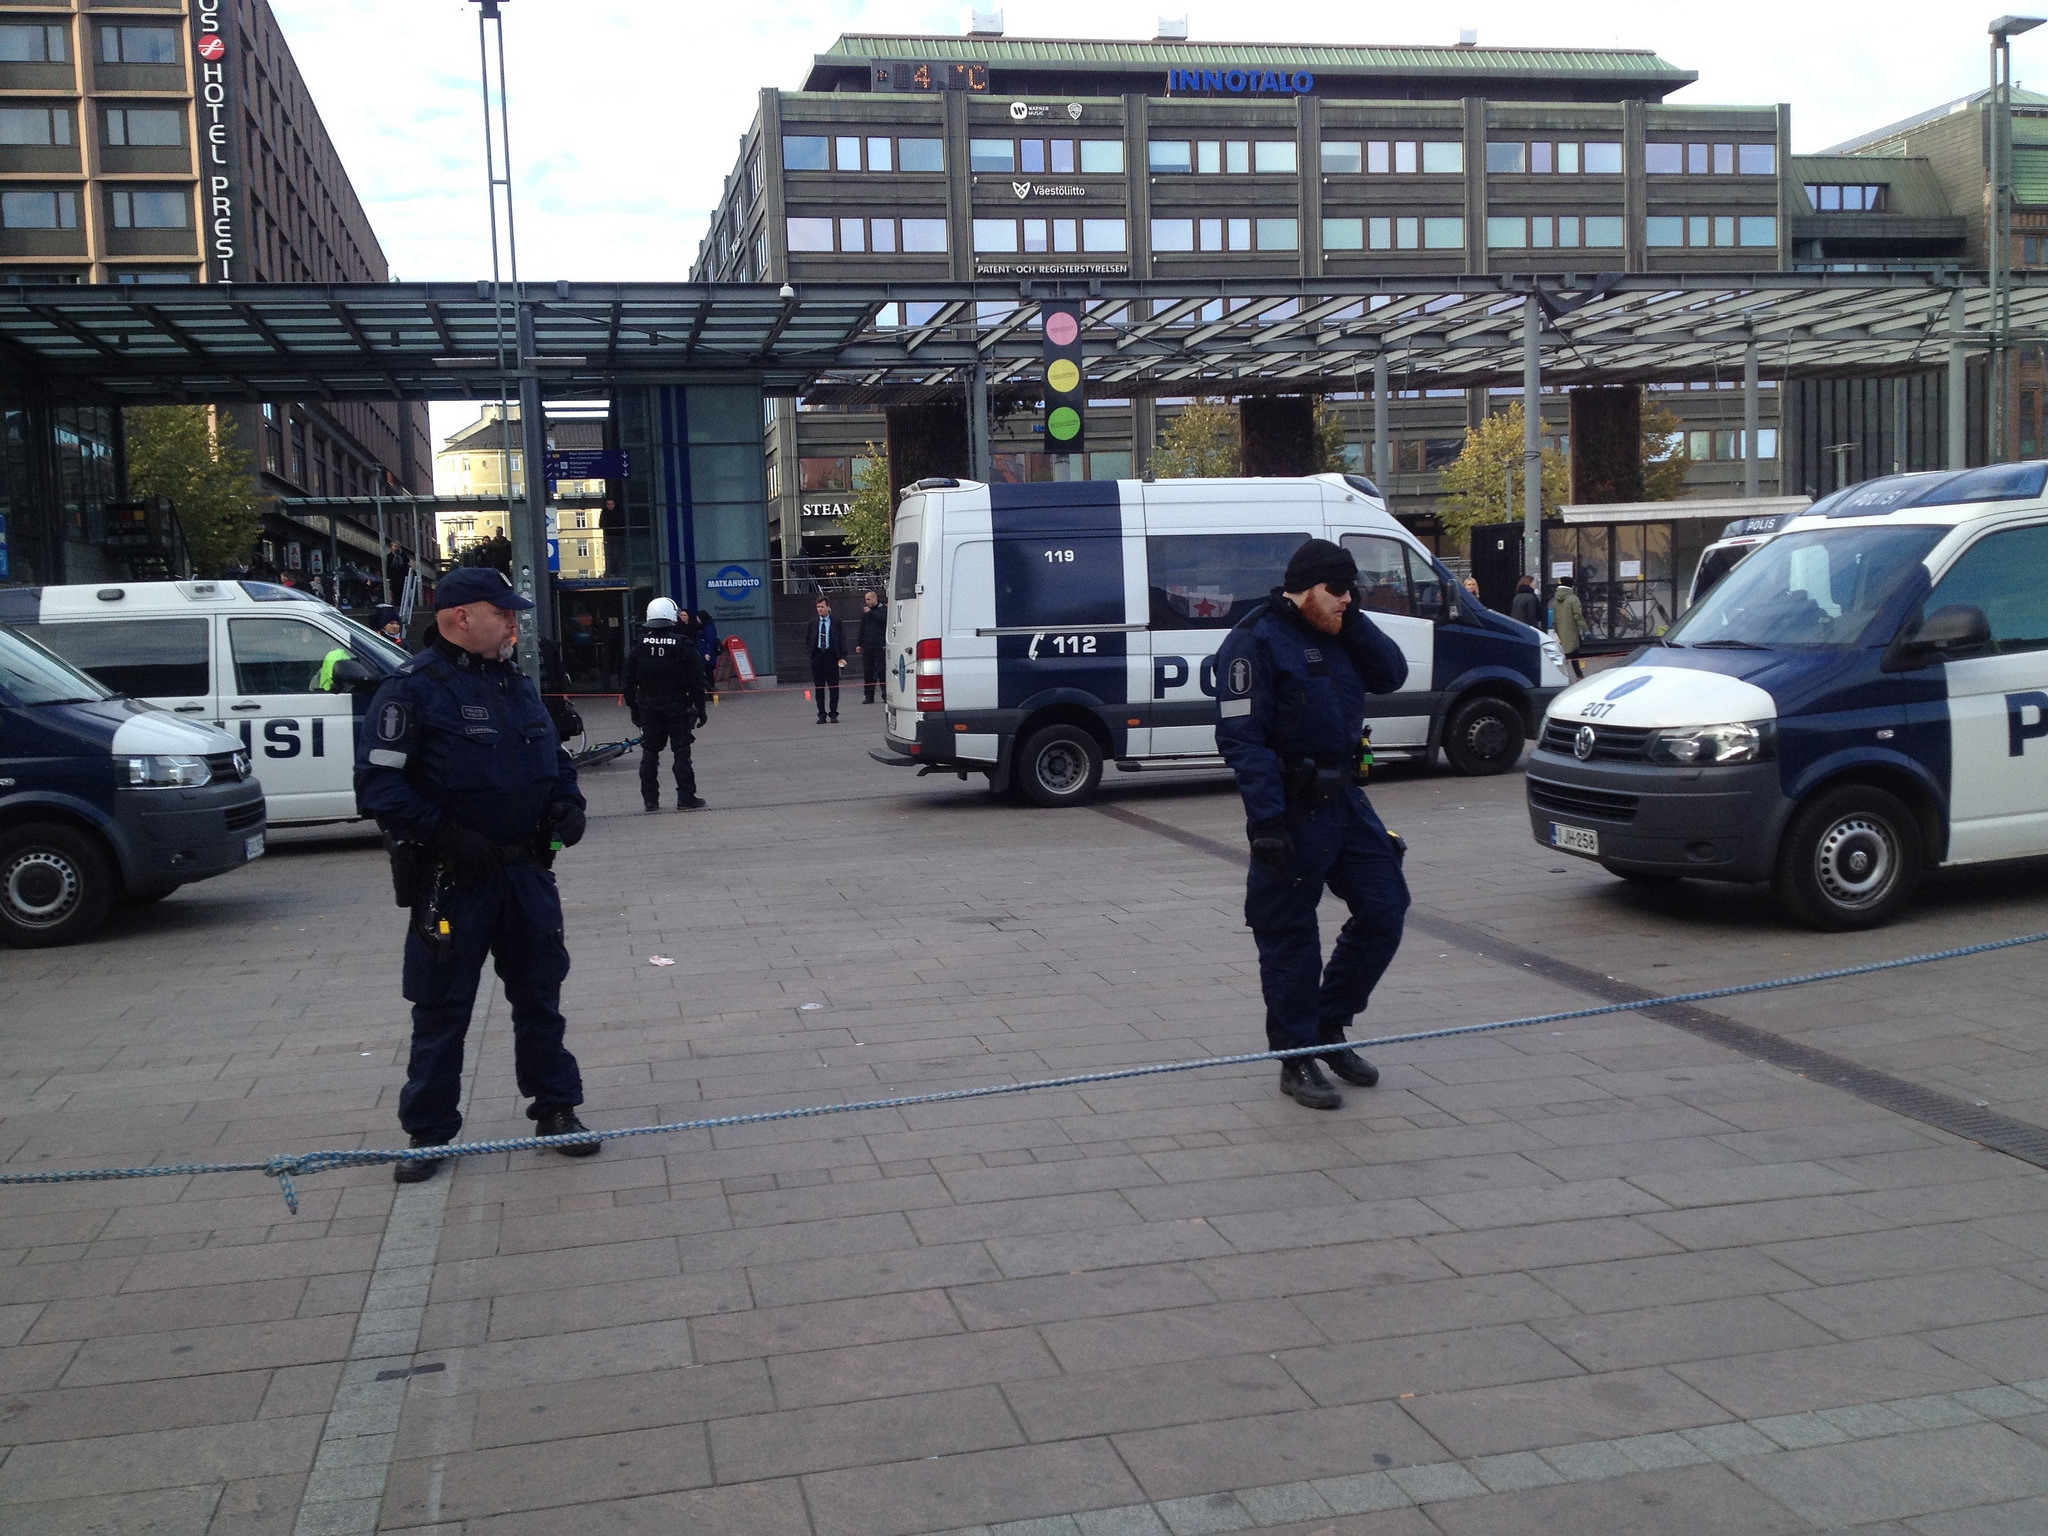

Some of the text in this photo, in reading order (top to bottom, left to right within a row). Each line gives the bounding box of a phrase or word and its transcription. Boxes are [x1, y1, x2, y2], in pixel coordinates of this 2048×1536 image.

[1169, 68, 1313, 93] INNOTALO
[203, 63, 234, 283] HOTEL PRESI
[1032, 185, 1086, 196] Väestöliitto
[1016, 265, 1036, 274] OCH
[1039, 264, 1128, 274] REGISTERSTYRELSEN
[1746, 518, 1777, 531] POLIS
[1044, 550, 1075, 563] 119
[707, 578, 760, 588] MATKAHUOLTO
[642, 637, 677, 645] POLIISI
[1052, 635, 1097, 654] 112
[1580, 702, 1616, 719] 207
[2004, 691, 2048, 757] P
